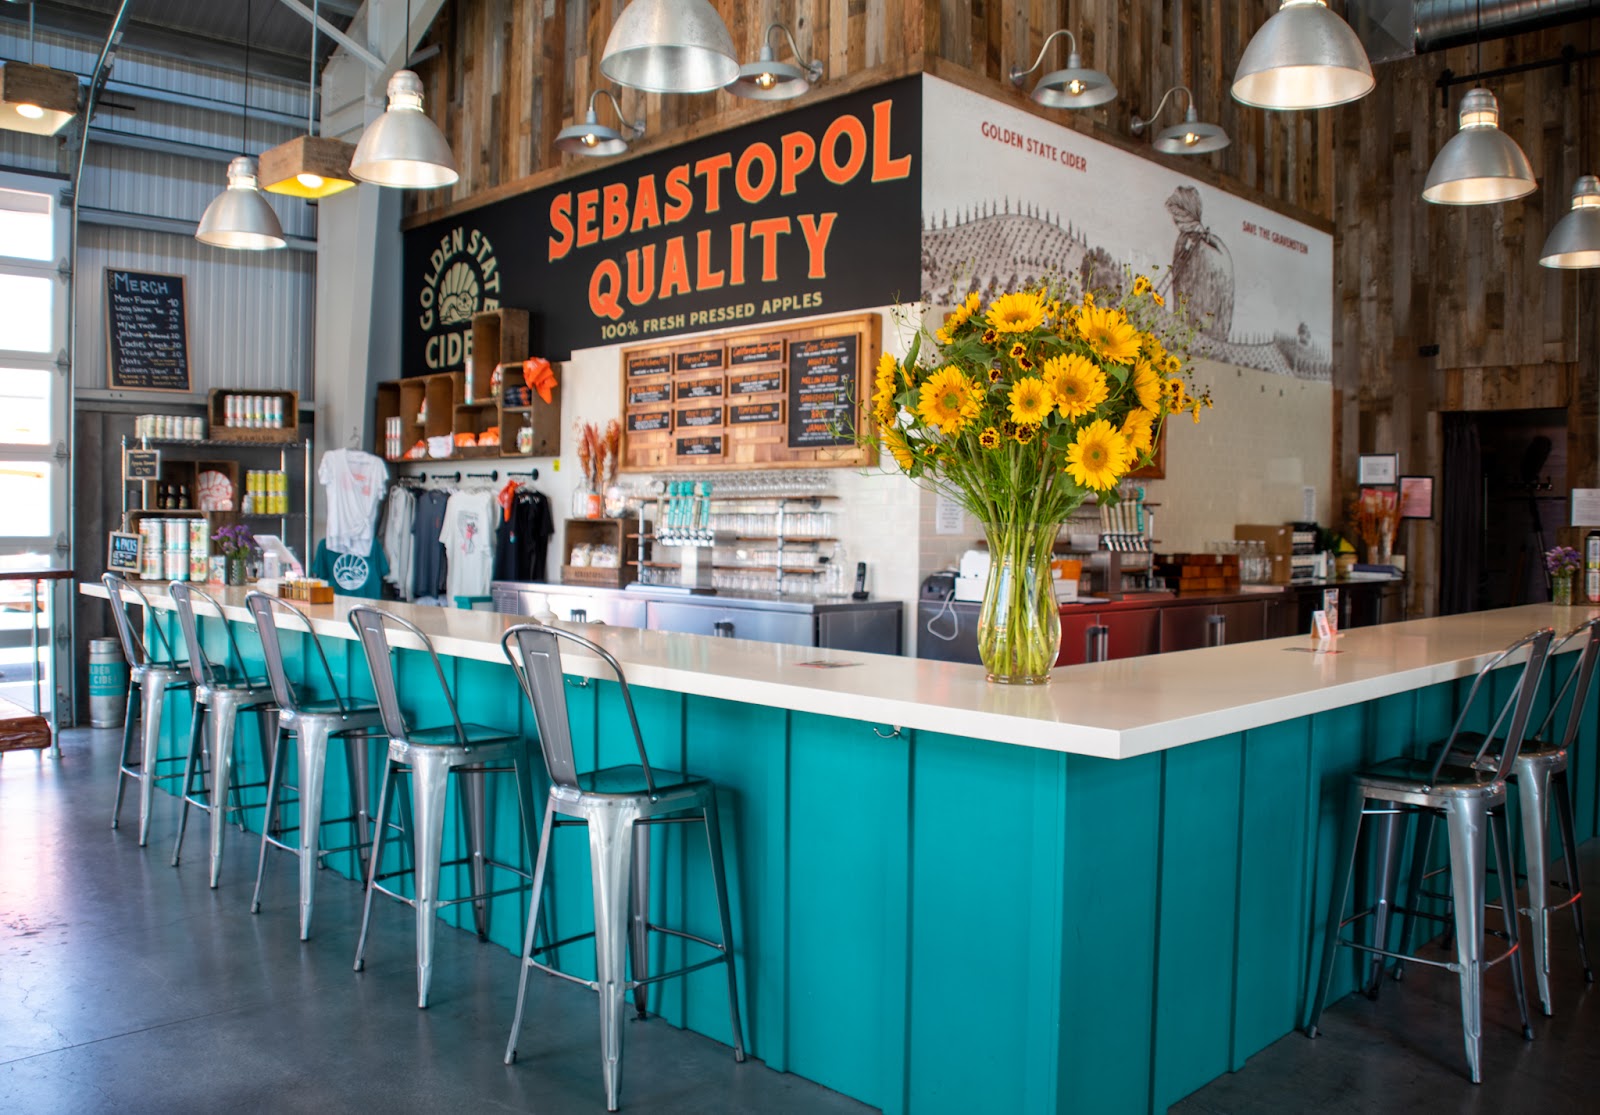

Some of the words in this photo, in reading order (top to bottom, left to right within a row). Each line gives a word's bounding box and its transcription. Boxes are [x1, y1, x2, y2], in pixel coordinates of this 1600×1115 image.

[981, 121, 1024, 149] GOLDEN
[1027, 137, 1058, 161] STATE
[1061, 150, 1087, 172] CIDER
[549, 99, 912, 262] SEBASTOPOL
[1242, 220, 1257, 235] SAVE
[1259, 226, 1270, 240] THE
[114, 272, 168, 295] MERCH
[420, 226, 464, 331] GOLDEN
[466, 229, 500, 312] STATE
[588, 212, 838, 320] QUALITY
[601, 317, 638, 339] 100%
[643, 315, 685, 333] FRESH
[690, 303, 755, 325] PRESSED
[761, 292, 823, 315] APPLES
[425, 328, 474, 369] CIDE
